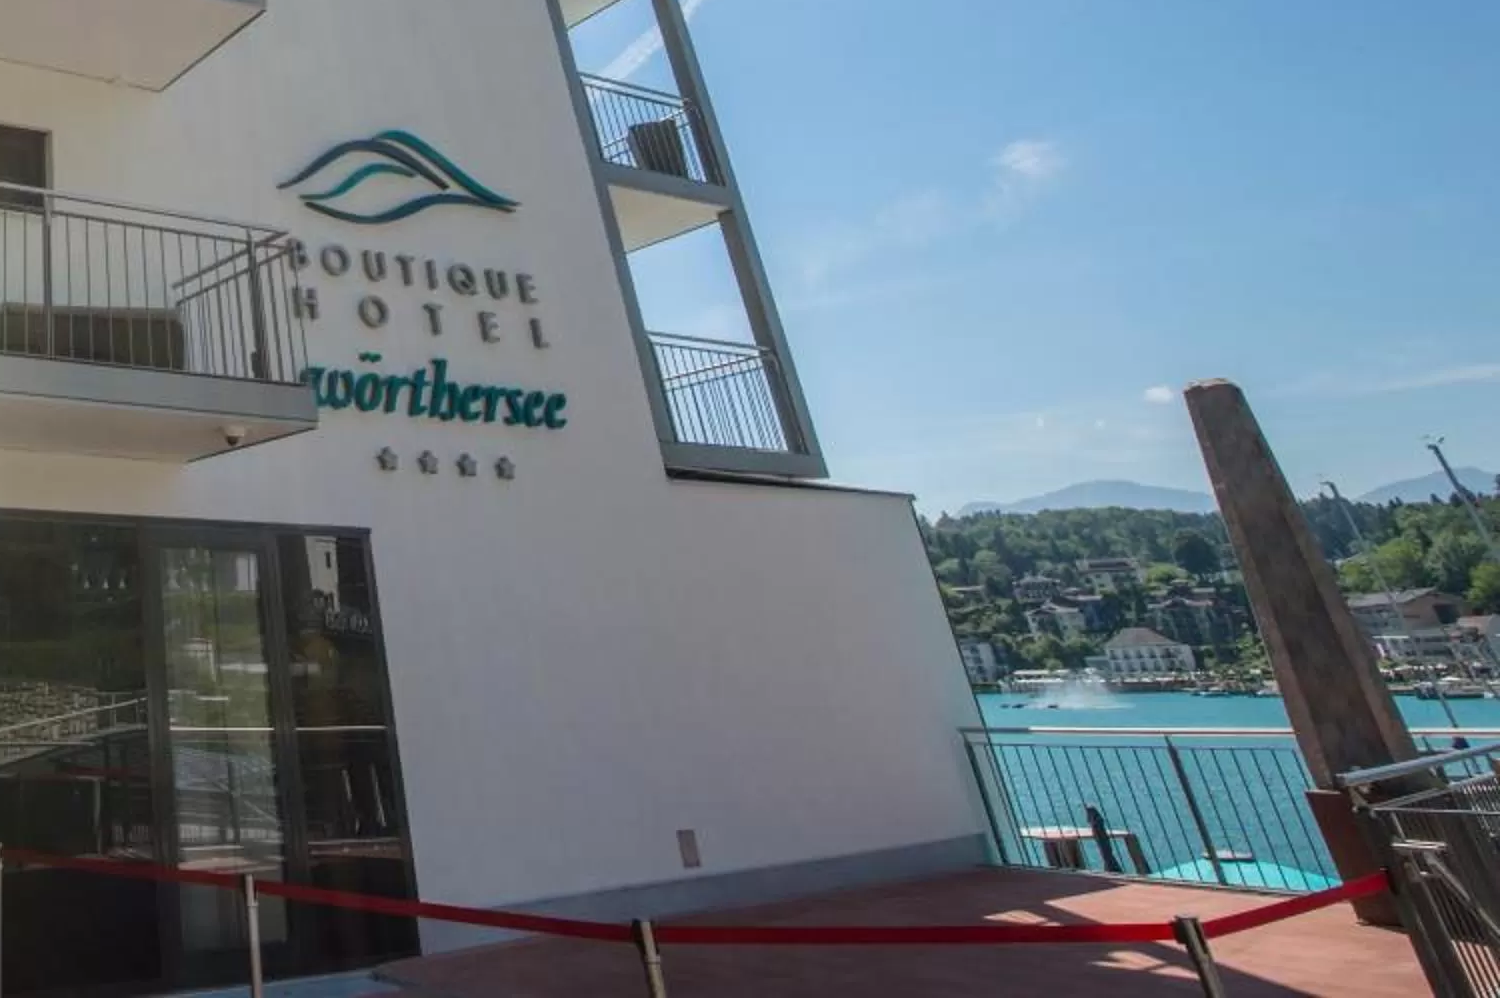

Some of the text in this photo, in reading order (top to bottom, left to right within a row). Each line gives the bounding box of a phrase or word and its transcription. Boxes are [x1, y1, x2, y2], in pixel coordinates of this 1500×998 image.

[287, 237, 539, 304] BOUTIQUE
[292, 285, 551, 349] HOTEL
[300, 352, 568, 430] wörthersee
